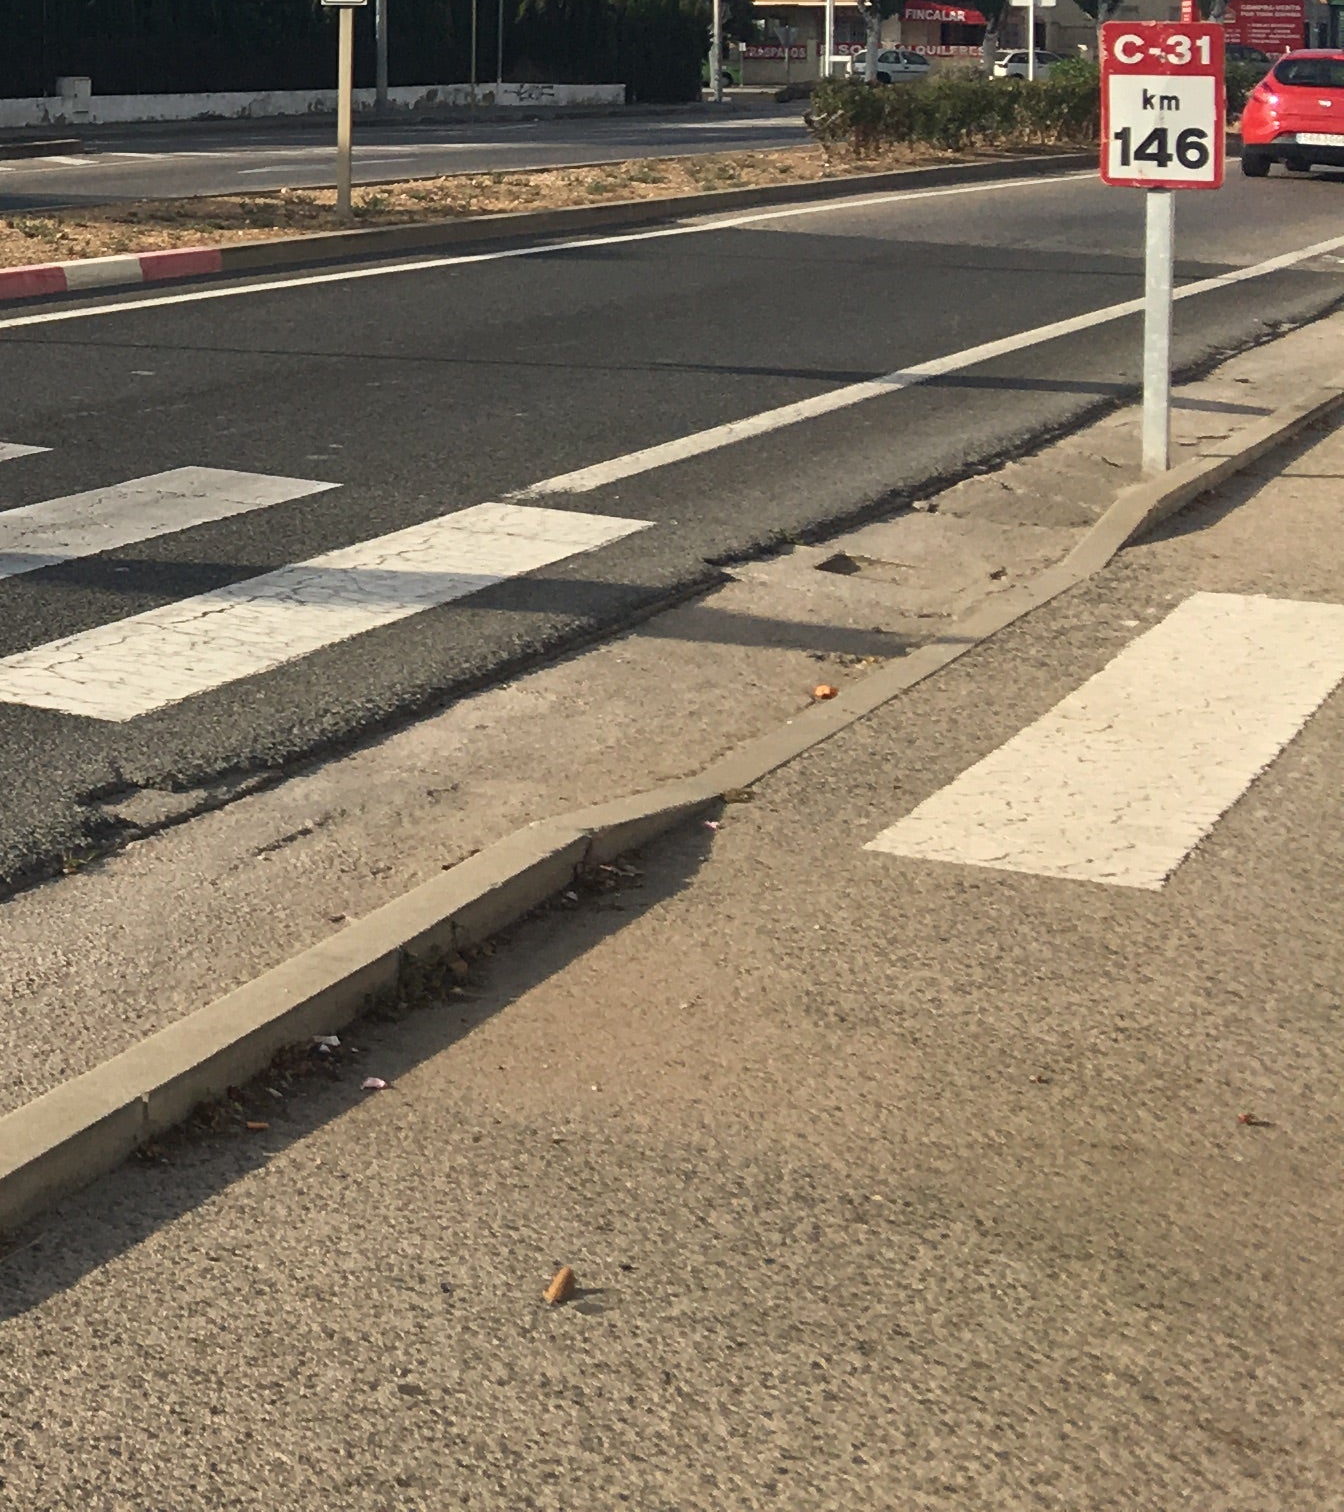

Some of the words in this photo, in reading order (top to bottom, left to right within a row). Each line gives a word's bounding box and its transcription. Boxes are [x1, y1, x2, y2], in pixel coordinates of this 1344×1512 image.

[905, 8, 966, 22] FINCALAR
[1114, 34, 1211, 65] C-31
[1142, 88, 1181, 111] km
[1114, 126, 1209, 170] 146
